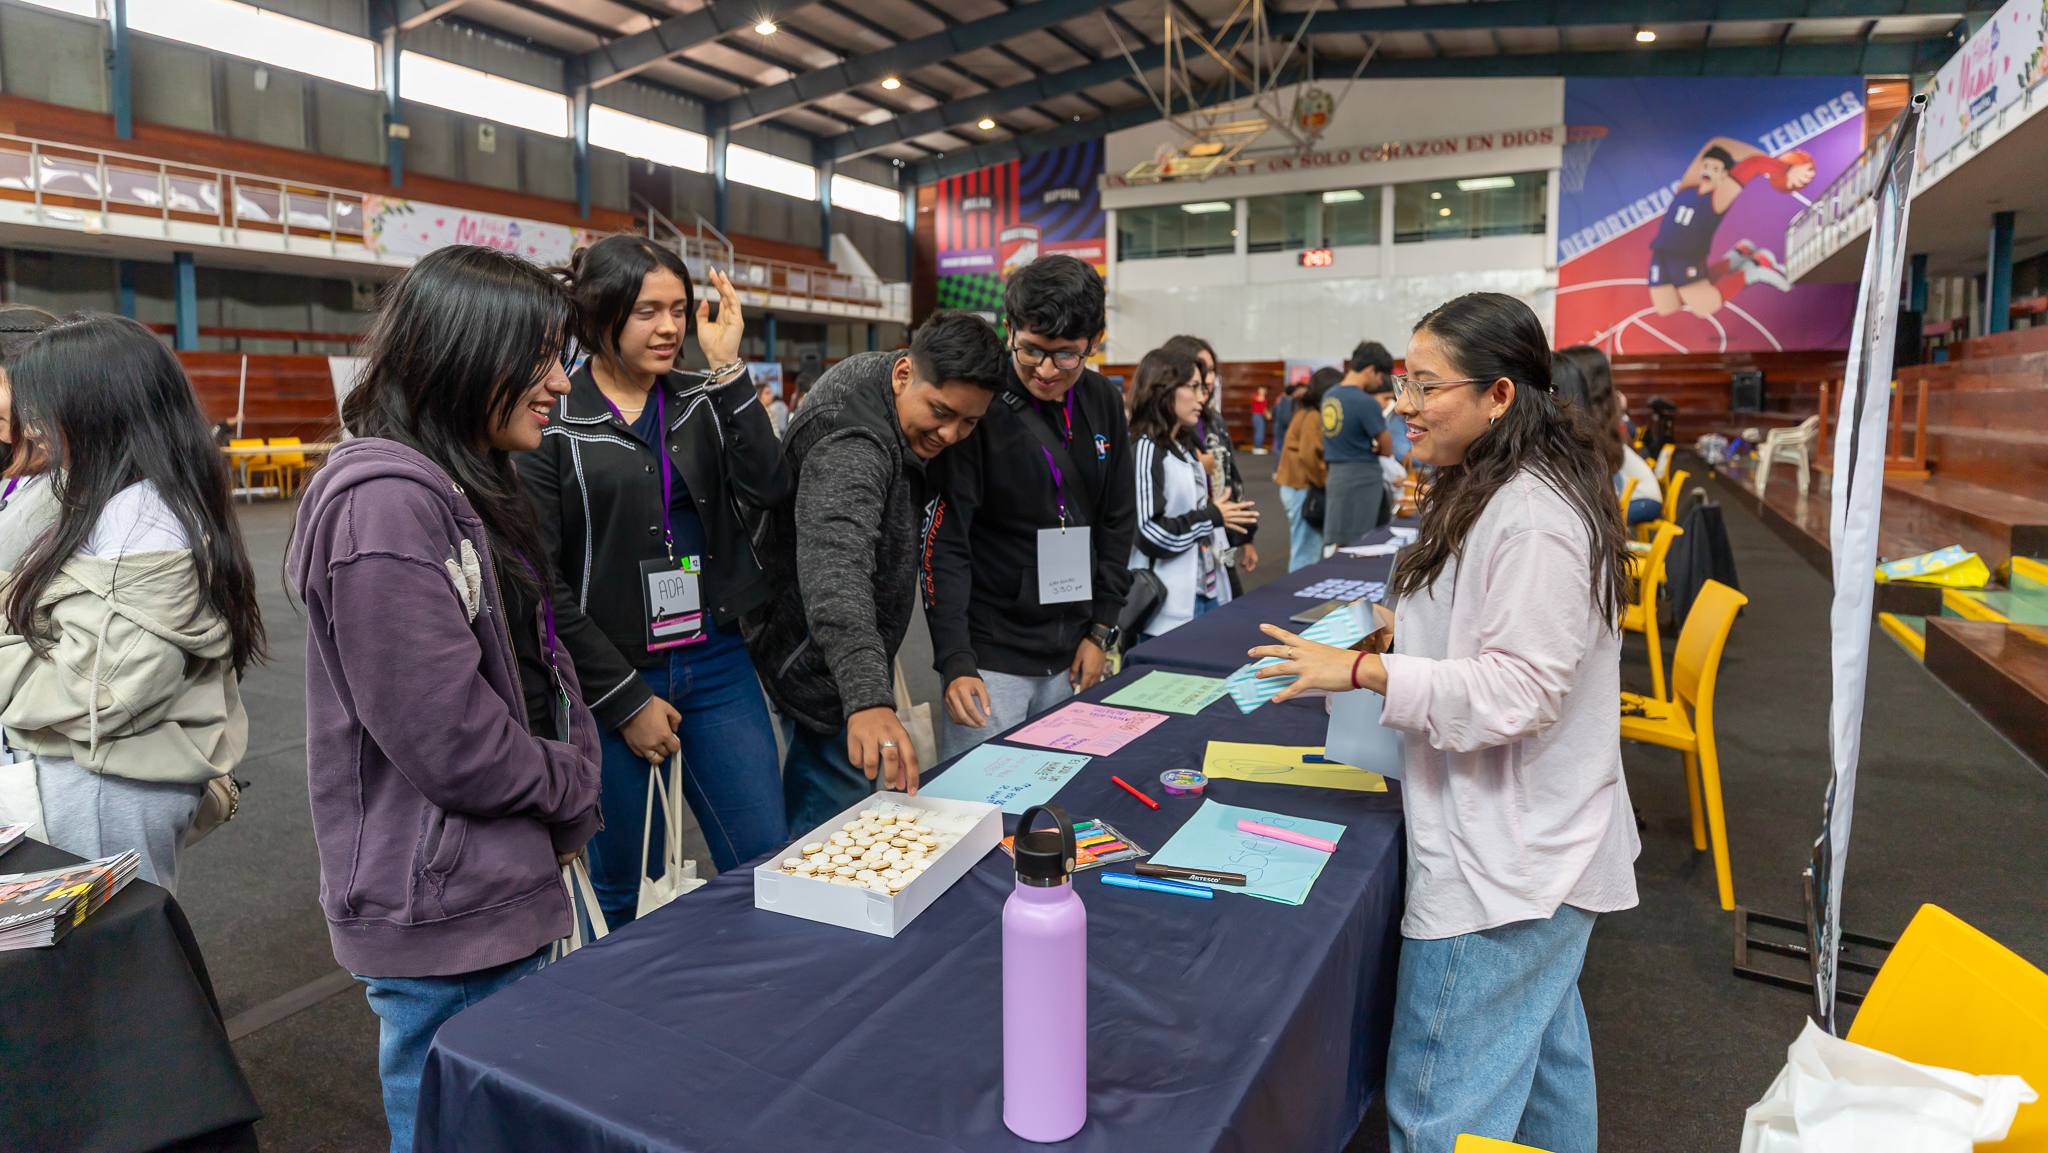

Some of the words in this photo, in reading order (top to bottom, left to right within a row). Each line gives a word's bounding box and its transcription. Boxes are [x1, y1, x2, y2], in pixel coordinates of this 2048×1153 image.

[1758, 91, 1862, 154] TENACES
[1300, 149, 1351, 168] SOLO
[1466, 134, 1494, 151] EN
[1502, 126, 1555, 148] DIOS
[1674, 205, 1695, 226] 11
[925, 500, 947, 605] COMPETITION
[658, 576, 685, 600] ADA
